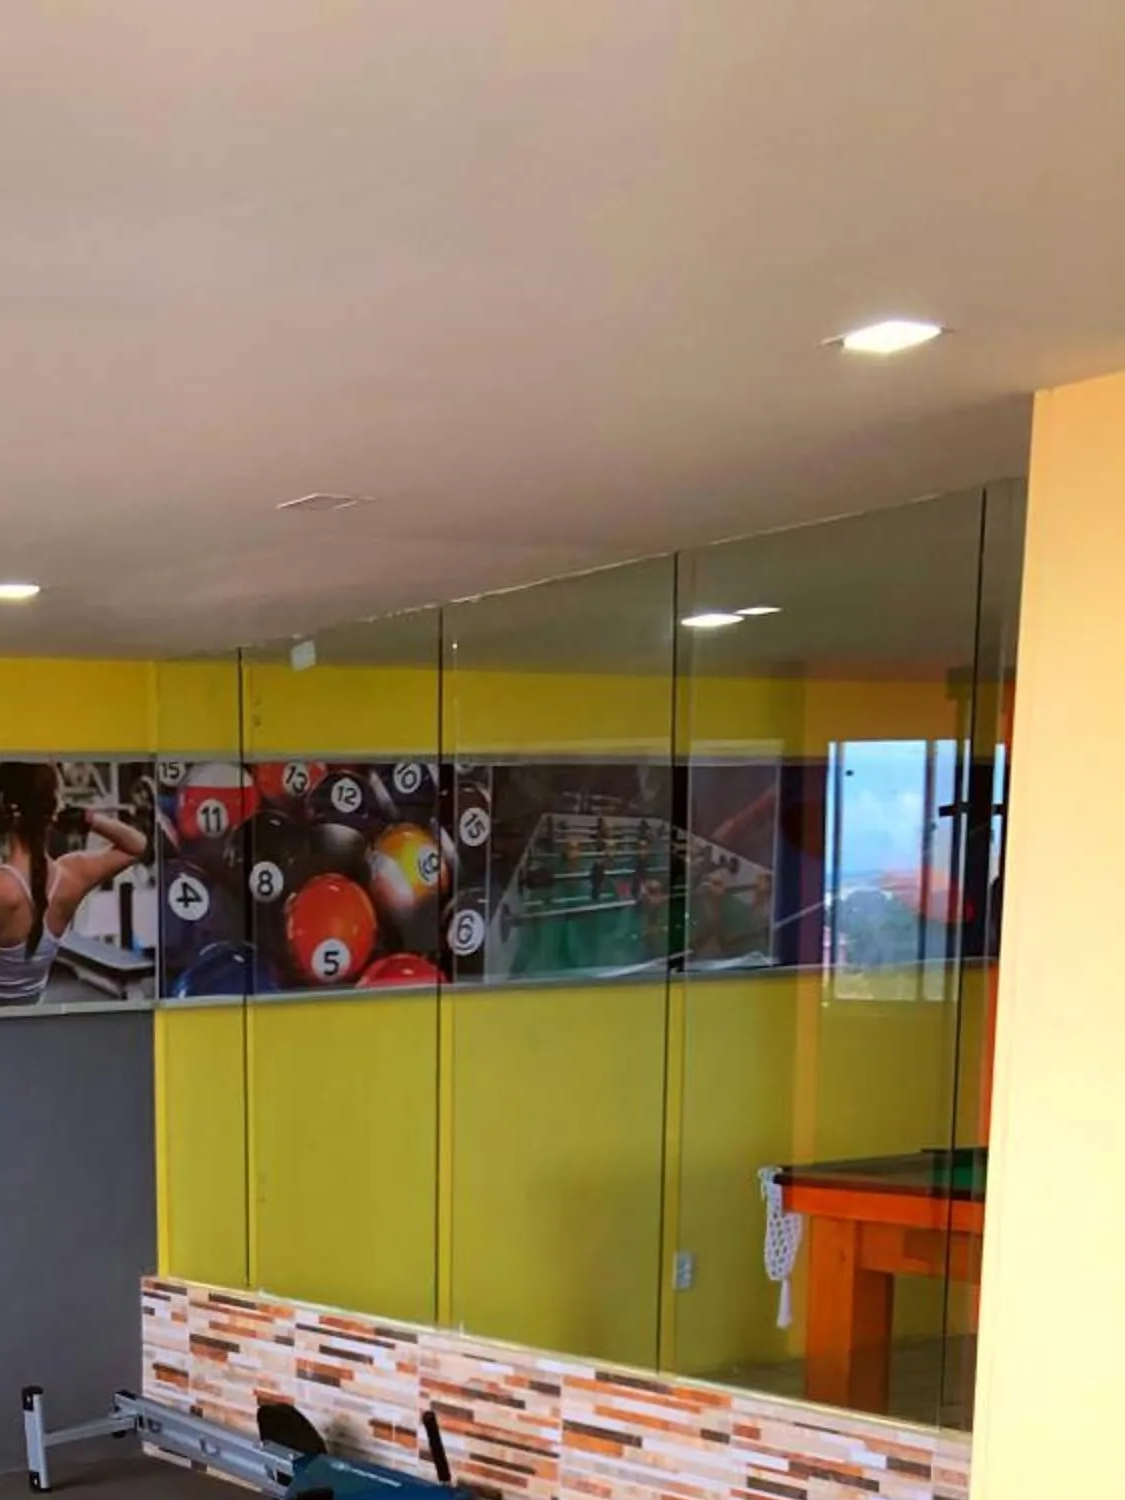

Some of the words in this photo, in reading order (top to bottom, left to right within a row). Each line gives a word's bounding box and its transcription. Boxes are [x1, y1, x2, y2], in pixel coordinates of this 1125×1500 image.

[337, 785, 358, 806] 12
[200, 806, 222, 833] 11
[464, 813, 486, 840] 15
[175, 883, 203, 908] 4
[258, 869, 274, 896] 8
[457, 915, 474, 945] 6
[324, 953, 340, 976] 5
